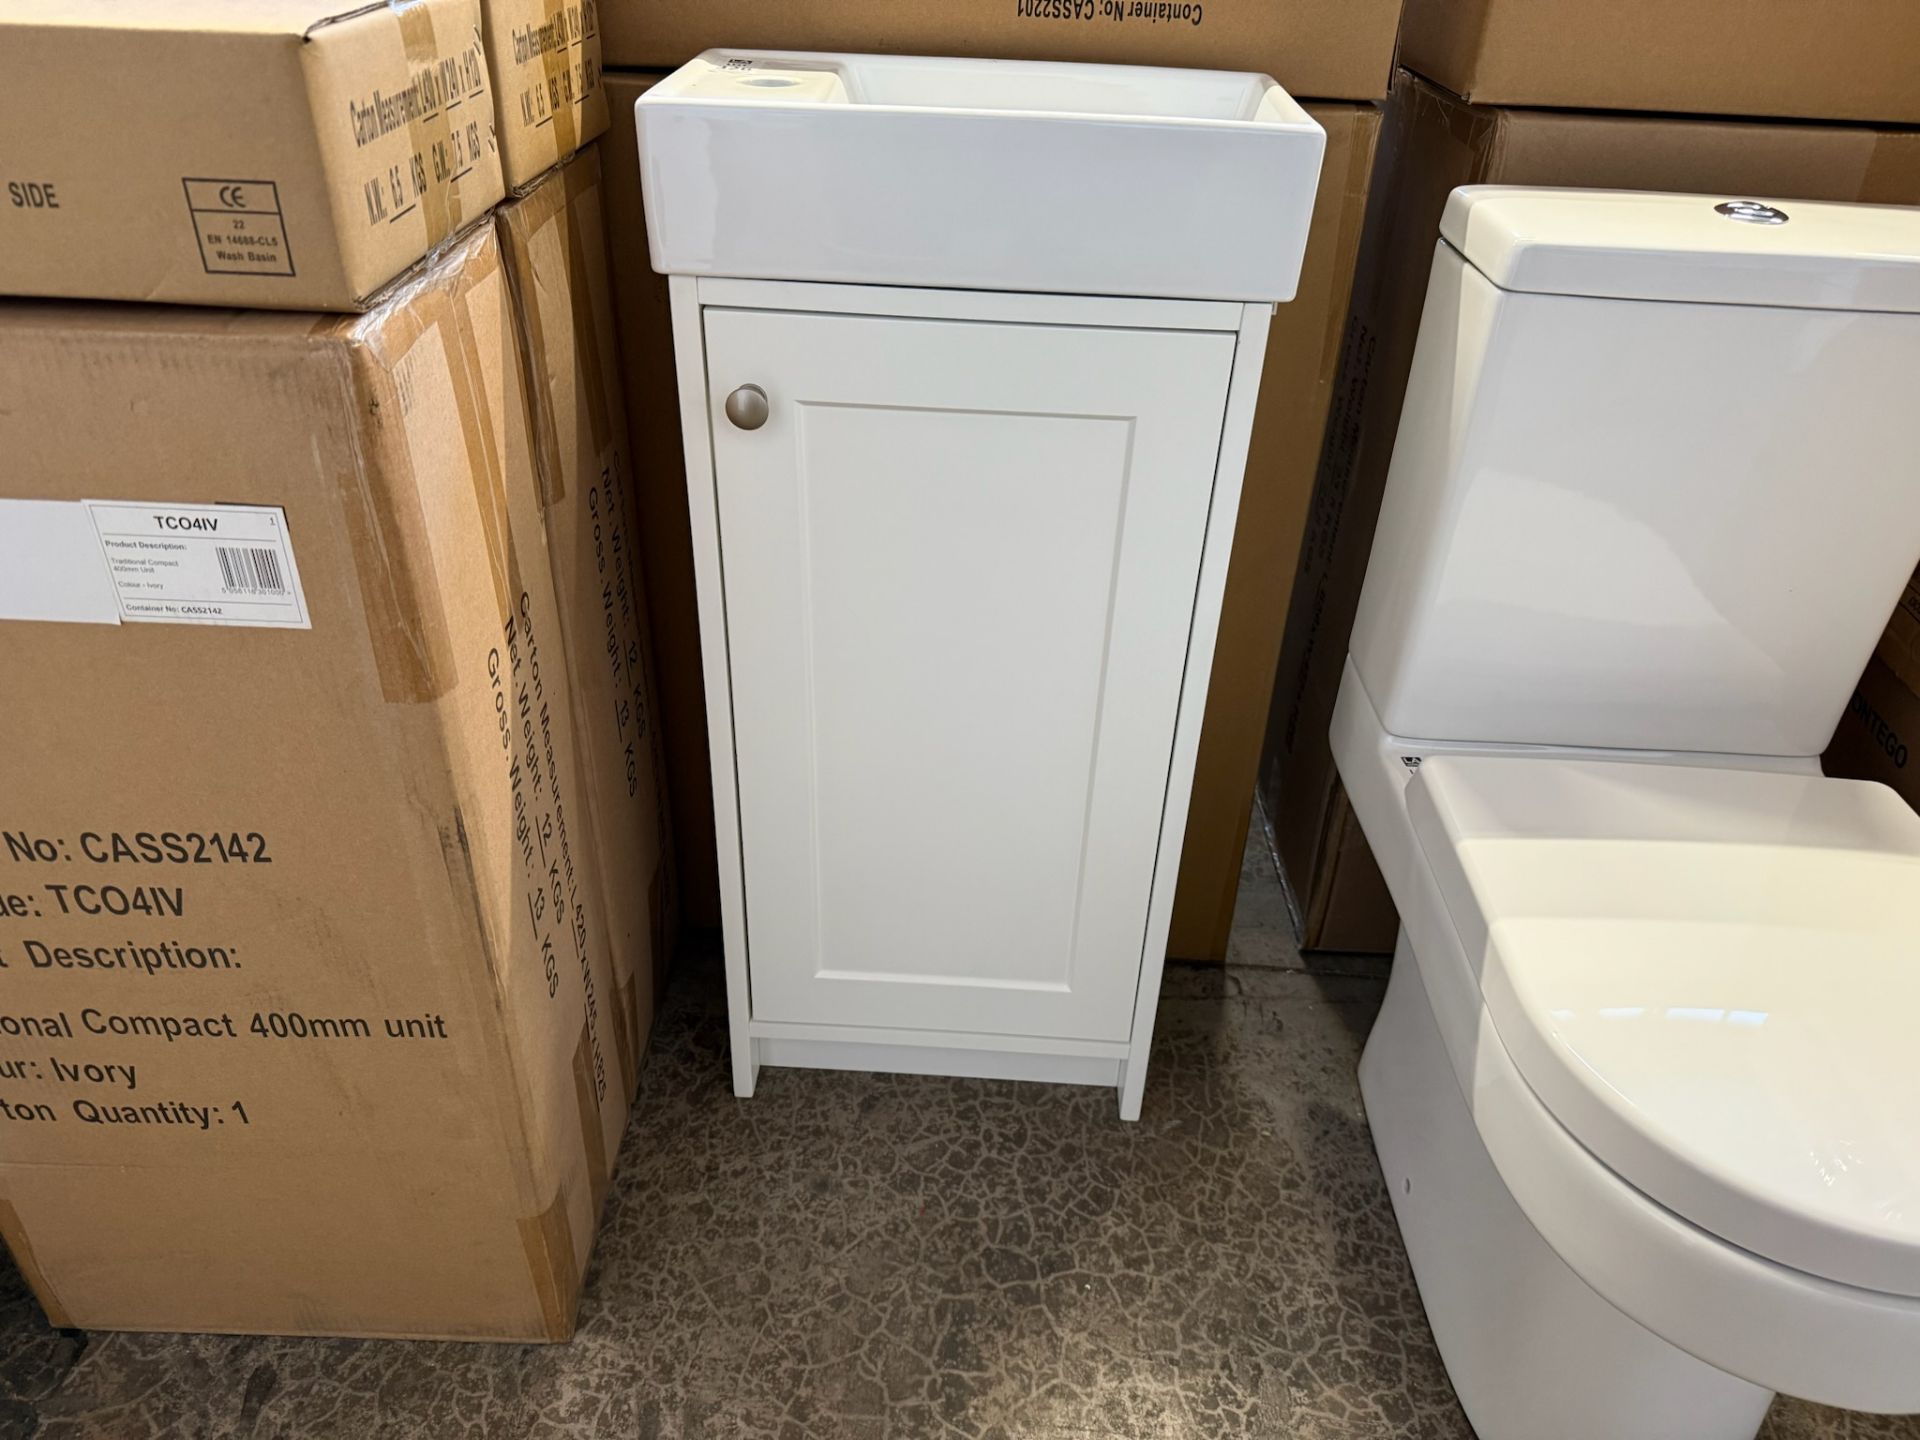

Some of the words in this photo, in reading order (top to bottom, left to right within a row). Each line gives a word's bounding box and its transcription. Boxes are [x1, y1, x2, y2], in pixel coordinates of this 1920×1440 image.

[1018, 0, 1095, 20] CASS2201
[1099, 0, 1124, 22] No:
[1128, 0, 1202, 26] Container
[350, 99, 379, 148] Carton
[409, 151, 428, 198] KGS
[466, 120, 481, 162] KGS
[8, 182, 60, 208] SIDE
[233, 220, 245, 230] 22
[207, 234, 222, 245] EN
[216, 251, 244, 261] Wash
[248, 252, 277, 263] Basin
[153, 515, 219, 531] TCO4IV
[270, 517, 276, 526] 1
[105, 540, 137, 550] Product
[139, 541, 187, 552] Description:
[111, 557, 146, 567] Traditional
[148, 559, 179, 569] Compact
[118, 580, 142, 589] Colour
[147, 582, 164, 591] Ivory
[126, 603, 163, 614] Container
[165, 605, 180, 614] No:
[181, 606, 222, 616] CASS2142
[520, 591, 544, 701] Carton
[624, 741, 638, 798] KGS
[2, 831, 72, 863] No:
[79, 832, 273, 864] CASS2142
[540, 812, 552, 847] 12
[548, 858, 565, 925] KGS
[44, 884, 183, 917] TCO4IV
[533, 886, 546, 922] 13
[541, 932, 560, 1000] KGS
[22, 940, 242, 976] Description:
[80, 1008, 238, 1043] Compact
[249, 1012, 372, 1039] 400mm
[384, 1012, 448, 1039] unit
[0, 1060, 42, 1080] ur:
[49, 1056, 137, 1090] Ivory
[0, 1099, 57, 1122] ton
[72, 1099, 224, 1130] Quantity:
[231, 1101, 250, 1125] 1
